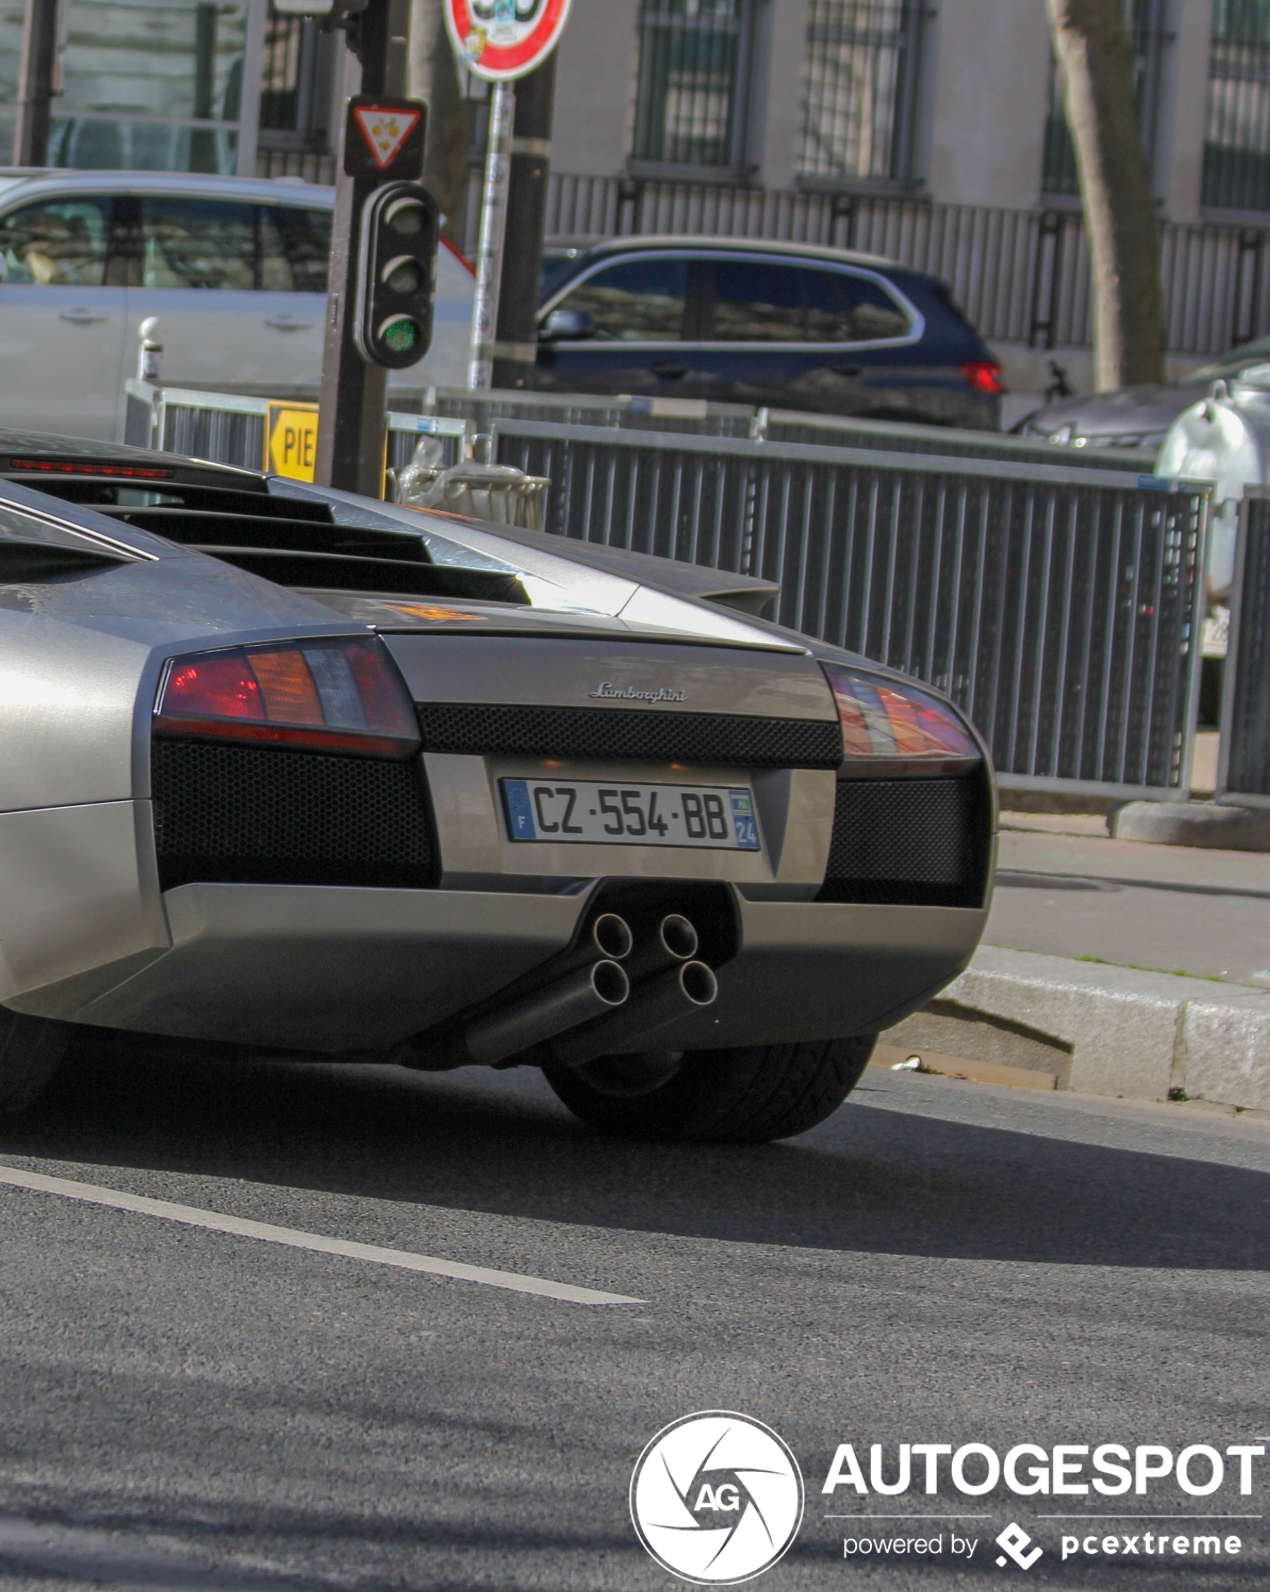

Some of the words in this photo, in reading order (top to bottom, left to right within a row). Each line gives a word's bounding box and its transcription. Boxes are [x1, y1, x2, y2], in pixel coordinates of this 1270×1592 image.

[590, 682, 687, 704] Lamborghini
[518, 815, 526, 829] F
[736, 822, 757, 843] 24
